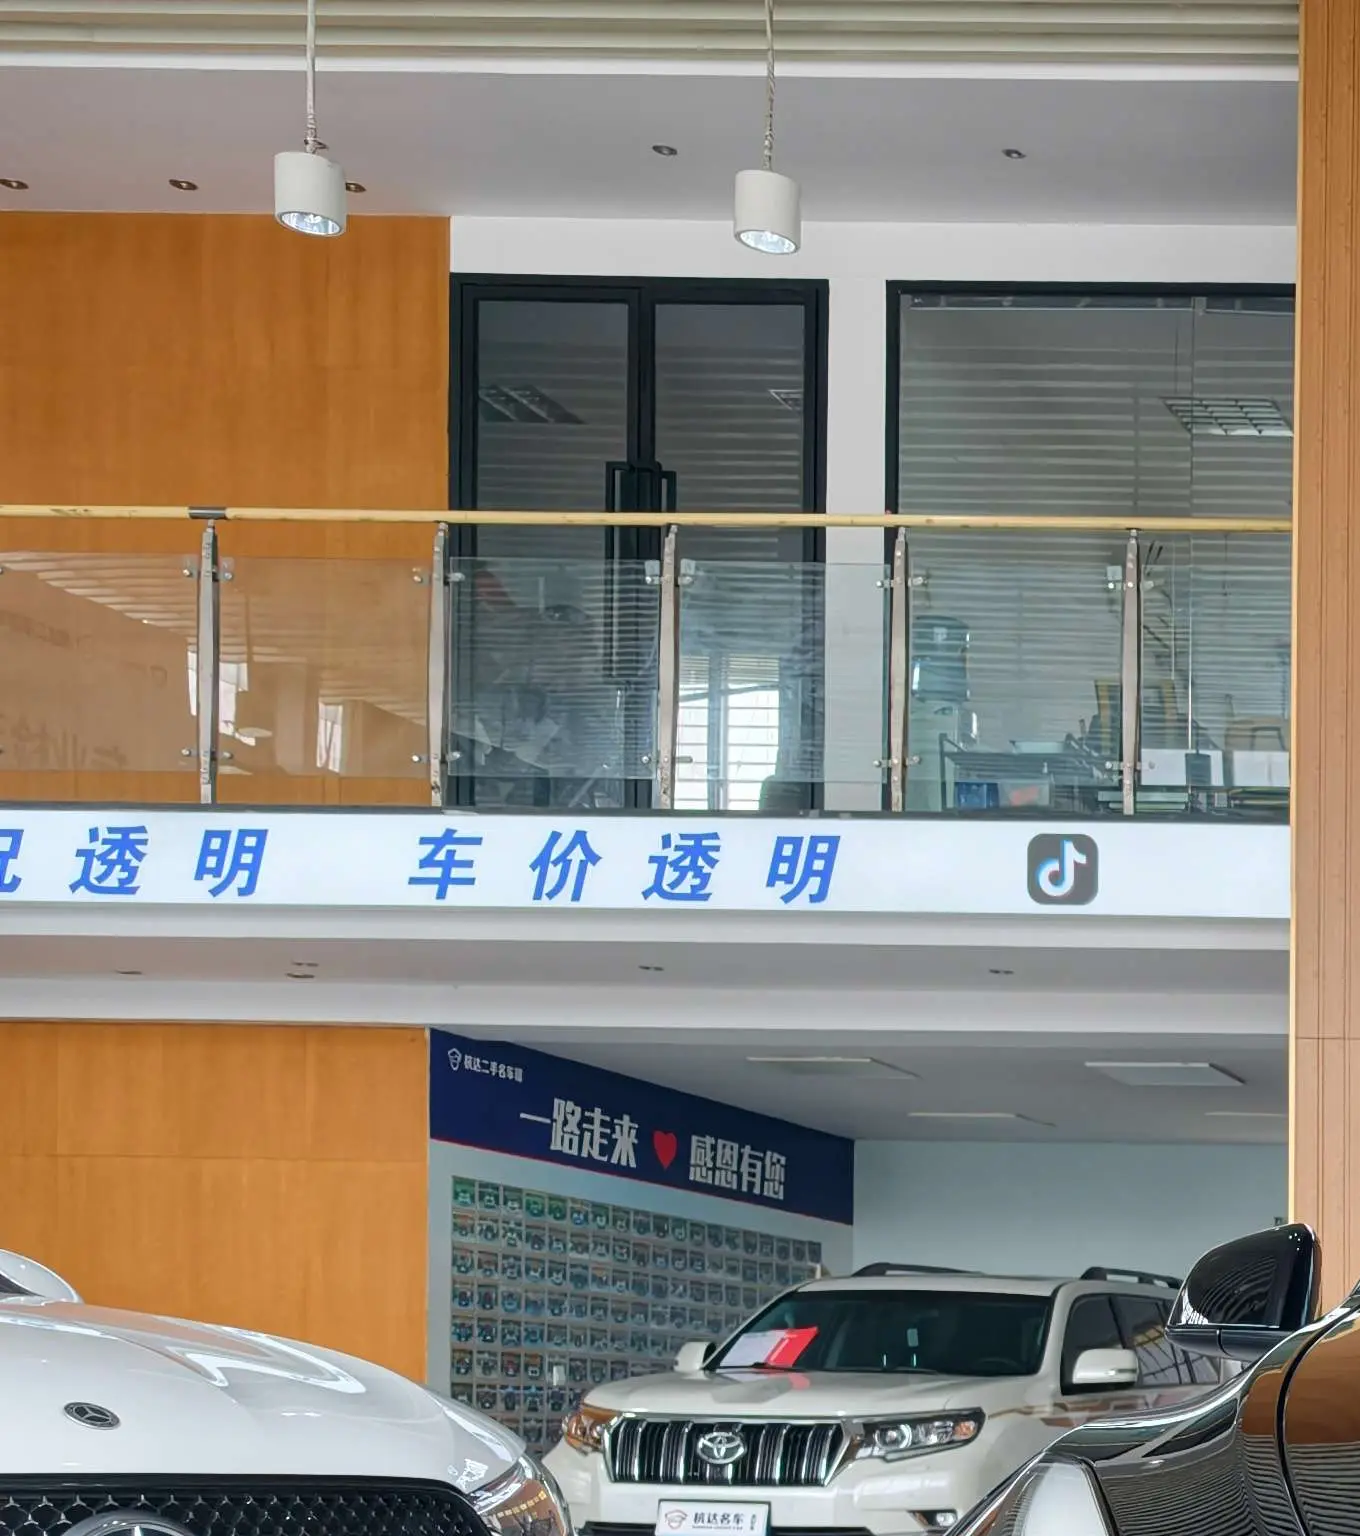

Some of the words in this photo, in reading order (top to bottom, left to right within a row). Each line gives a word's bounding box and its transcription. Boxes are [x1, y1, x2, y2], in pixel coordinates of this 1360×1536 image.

[407, 827, 841, 905] 车价透明
[519, 1097, 640, 1169] 一路走来
[688, 1134, 787, 1201] 感恩有您
